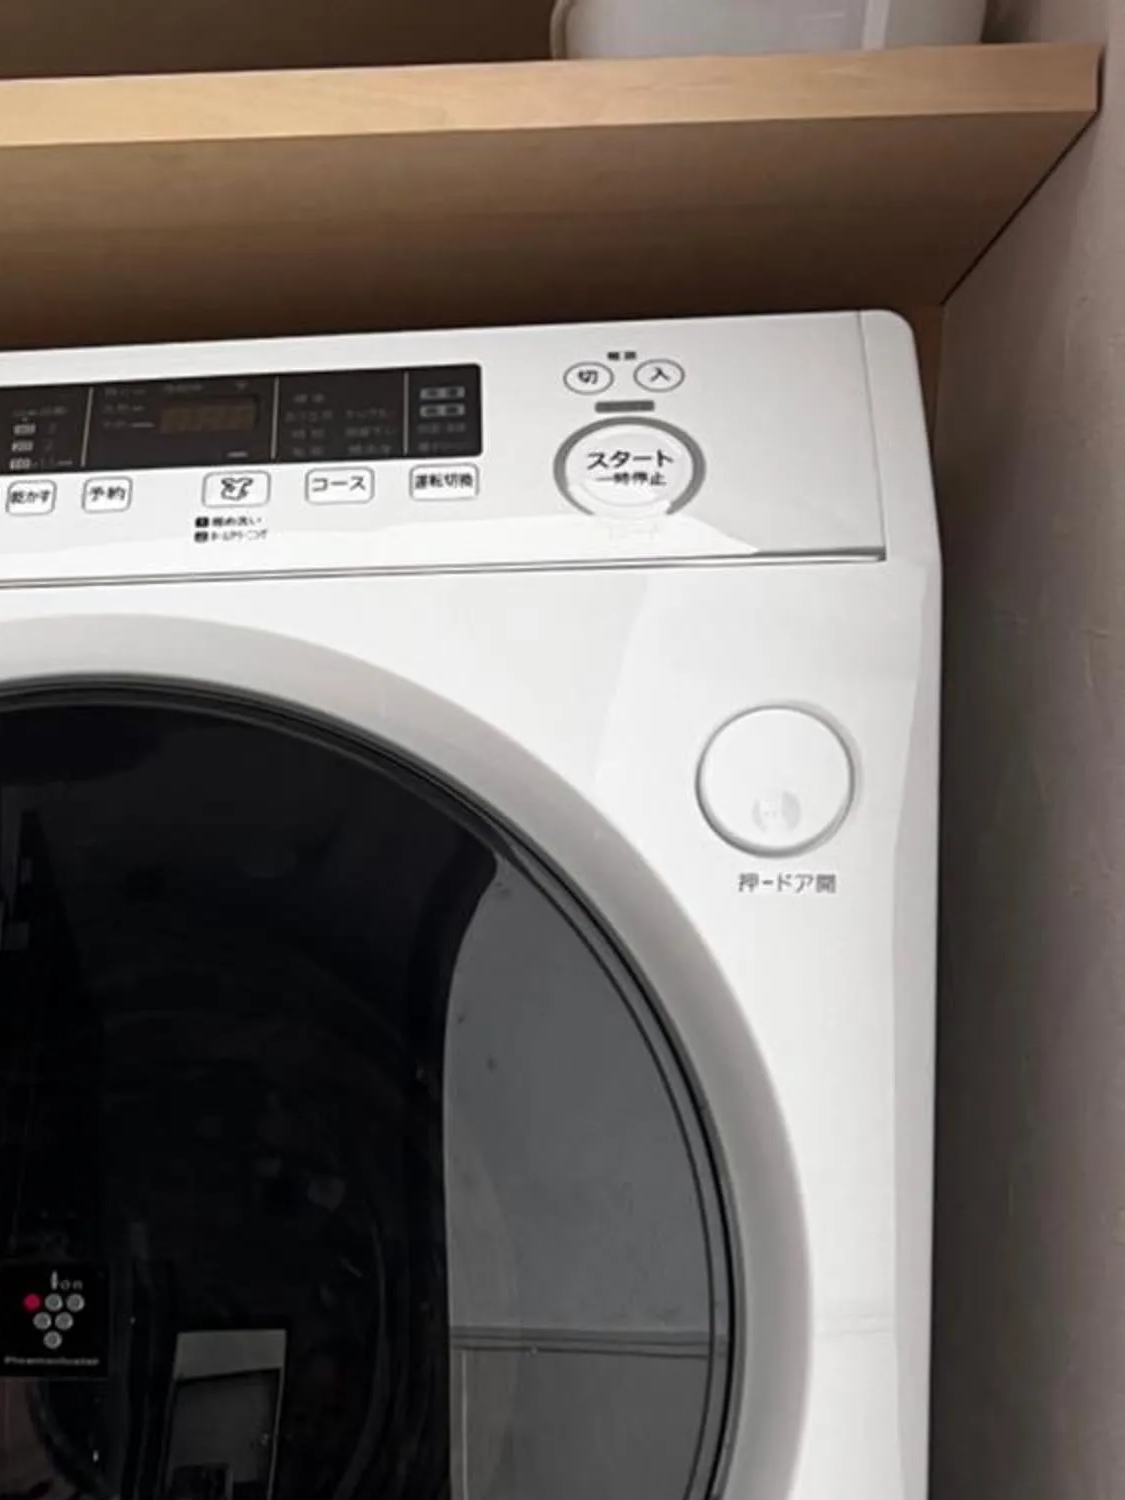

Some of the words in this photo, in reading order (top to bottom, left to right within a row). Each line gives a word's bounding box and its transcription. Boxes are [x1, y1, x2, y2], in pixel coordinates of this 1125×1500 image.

[577, 369, 599, 385] 切
[649, 366, 671, 382] 入
[587, 449, 674, 471] スタート
[311, 476, 367, 493] コース
[595, 471, 667, 486] 一時停止
[90, 485, 125, 502] 予約
